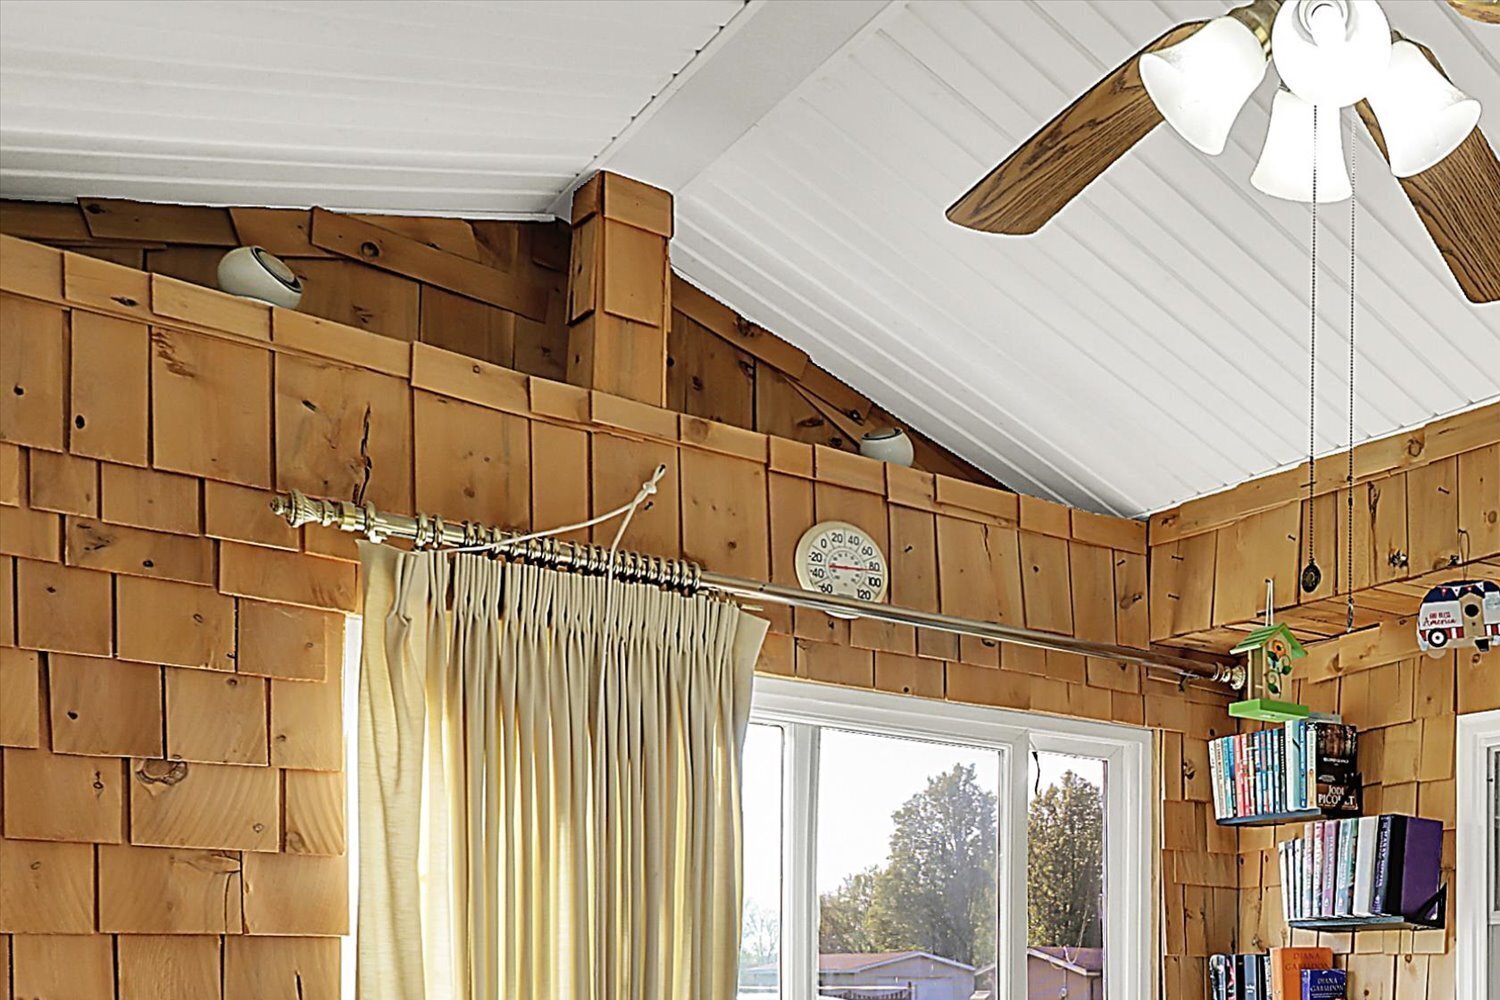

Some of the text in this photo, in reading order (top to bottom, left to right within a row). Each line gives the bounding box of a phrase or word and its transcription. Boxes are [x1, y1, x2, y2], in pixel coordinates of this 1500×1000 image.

[832, 533, 843, 543] 20
[848, 536, 859, 545] 40
[821, 539, 827, 548] 0
[861, 546, 873, 556] 60
[809, 552, 822, 562] -20
[869, 562, 879, 572] 80
[810, 569, 824, 578] -40
[868, 577, 881, 587] 100
[857, 589, 871, 600] 120
